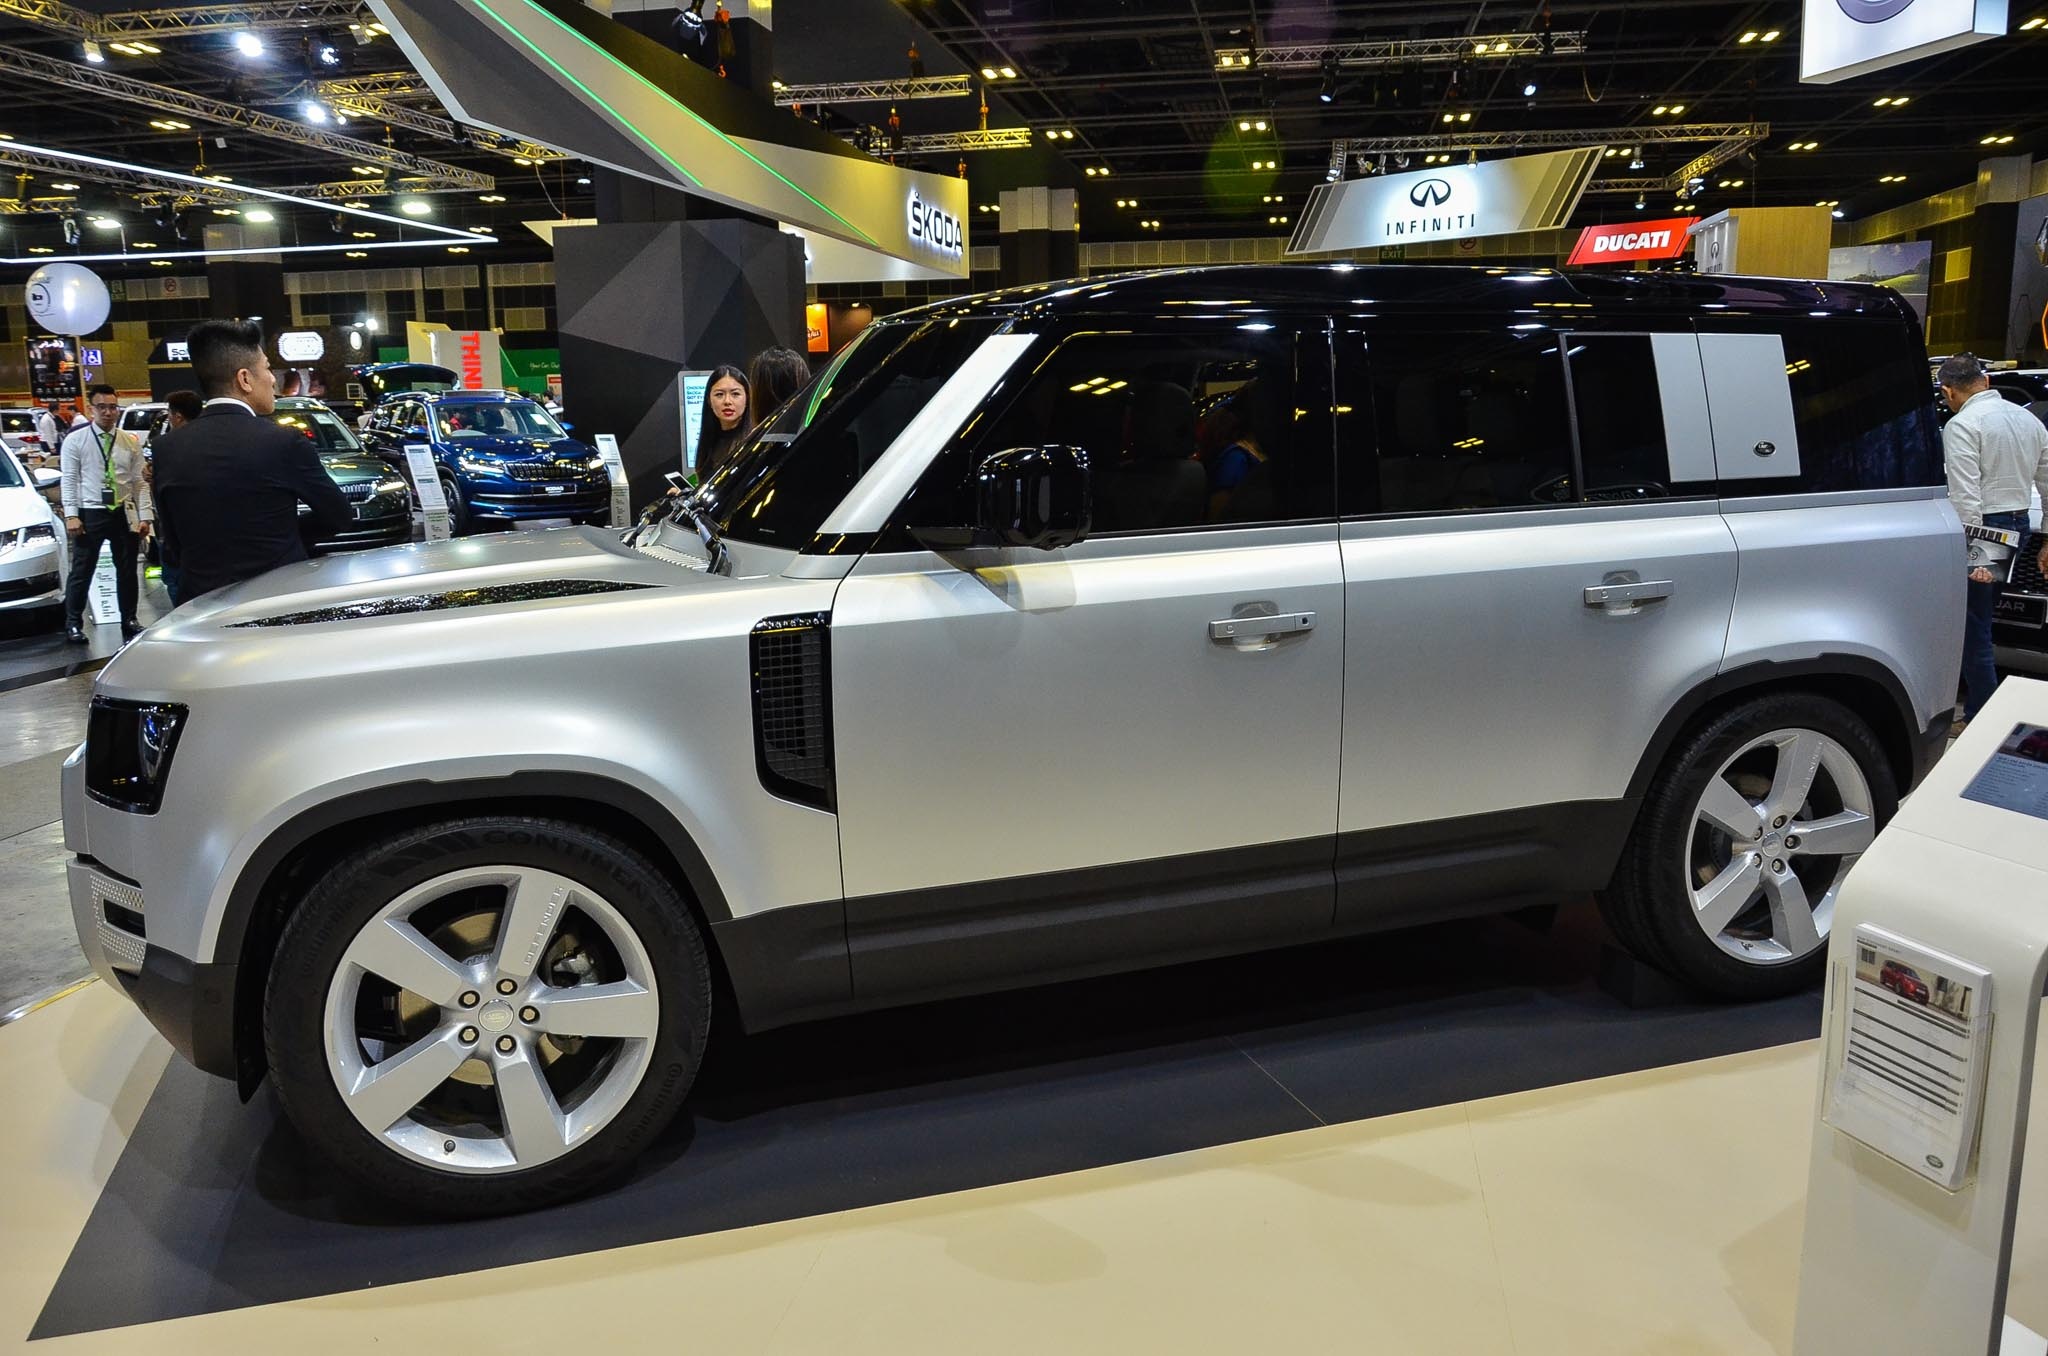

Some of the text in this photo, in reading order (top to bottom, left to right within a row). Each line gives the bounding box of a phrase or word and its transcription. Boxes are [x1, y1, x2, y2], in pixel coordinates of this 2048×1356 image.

[912, 191, 964, 253] ŠKODA
[1386, 213, 1475, 236] INFINITI
[1593, 230, 1672, 253] DUCATI
[1381, 249, 1402, 259] EXIT
